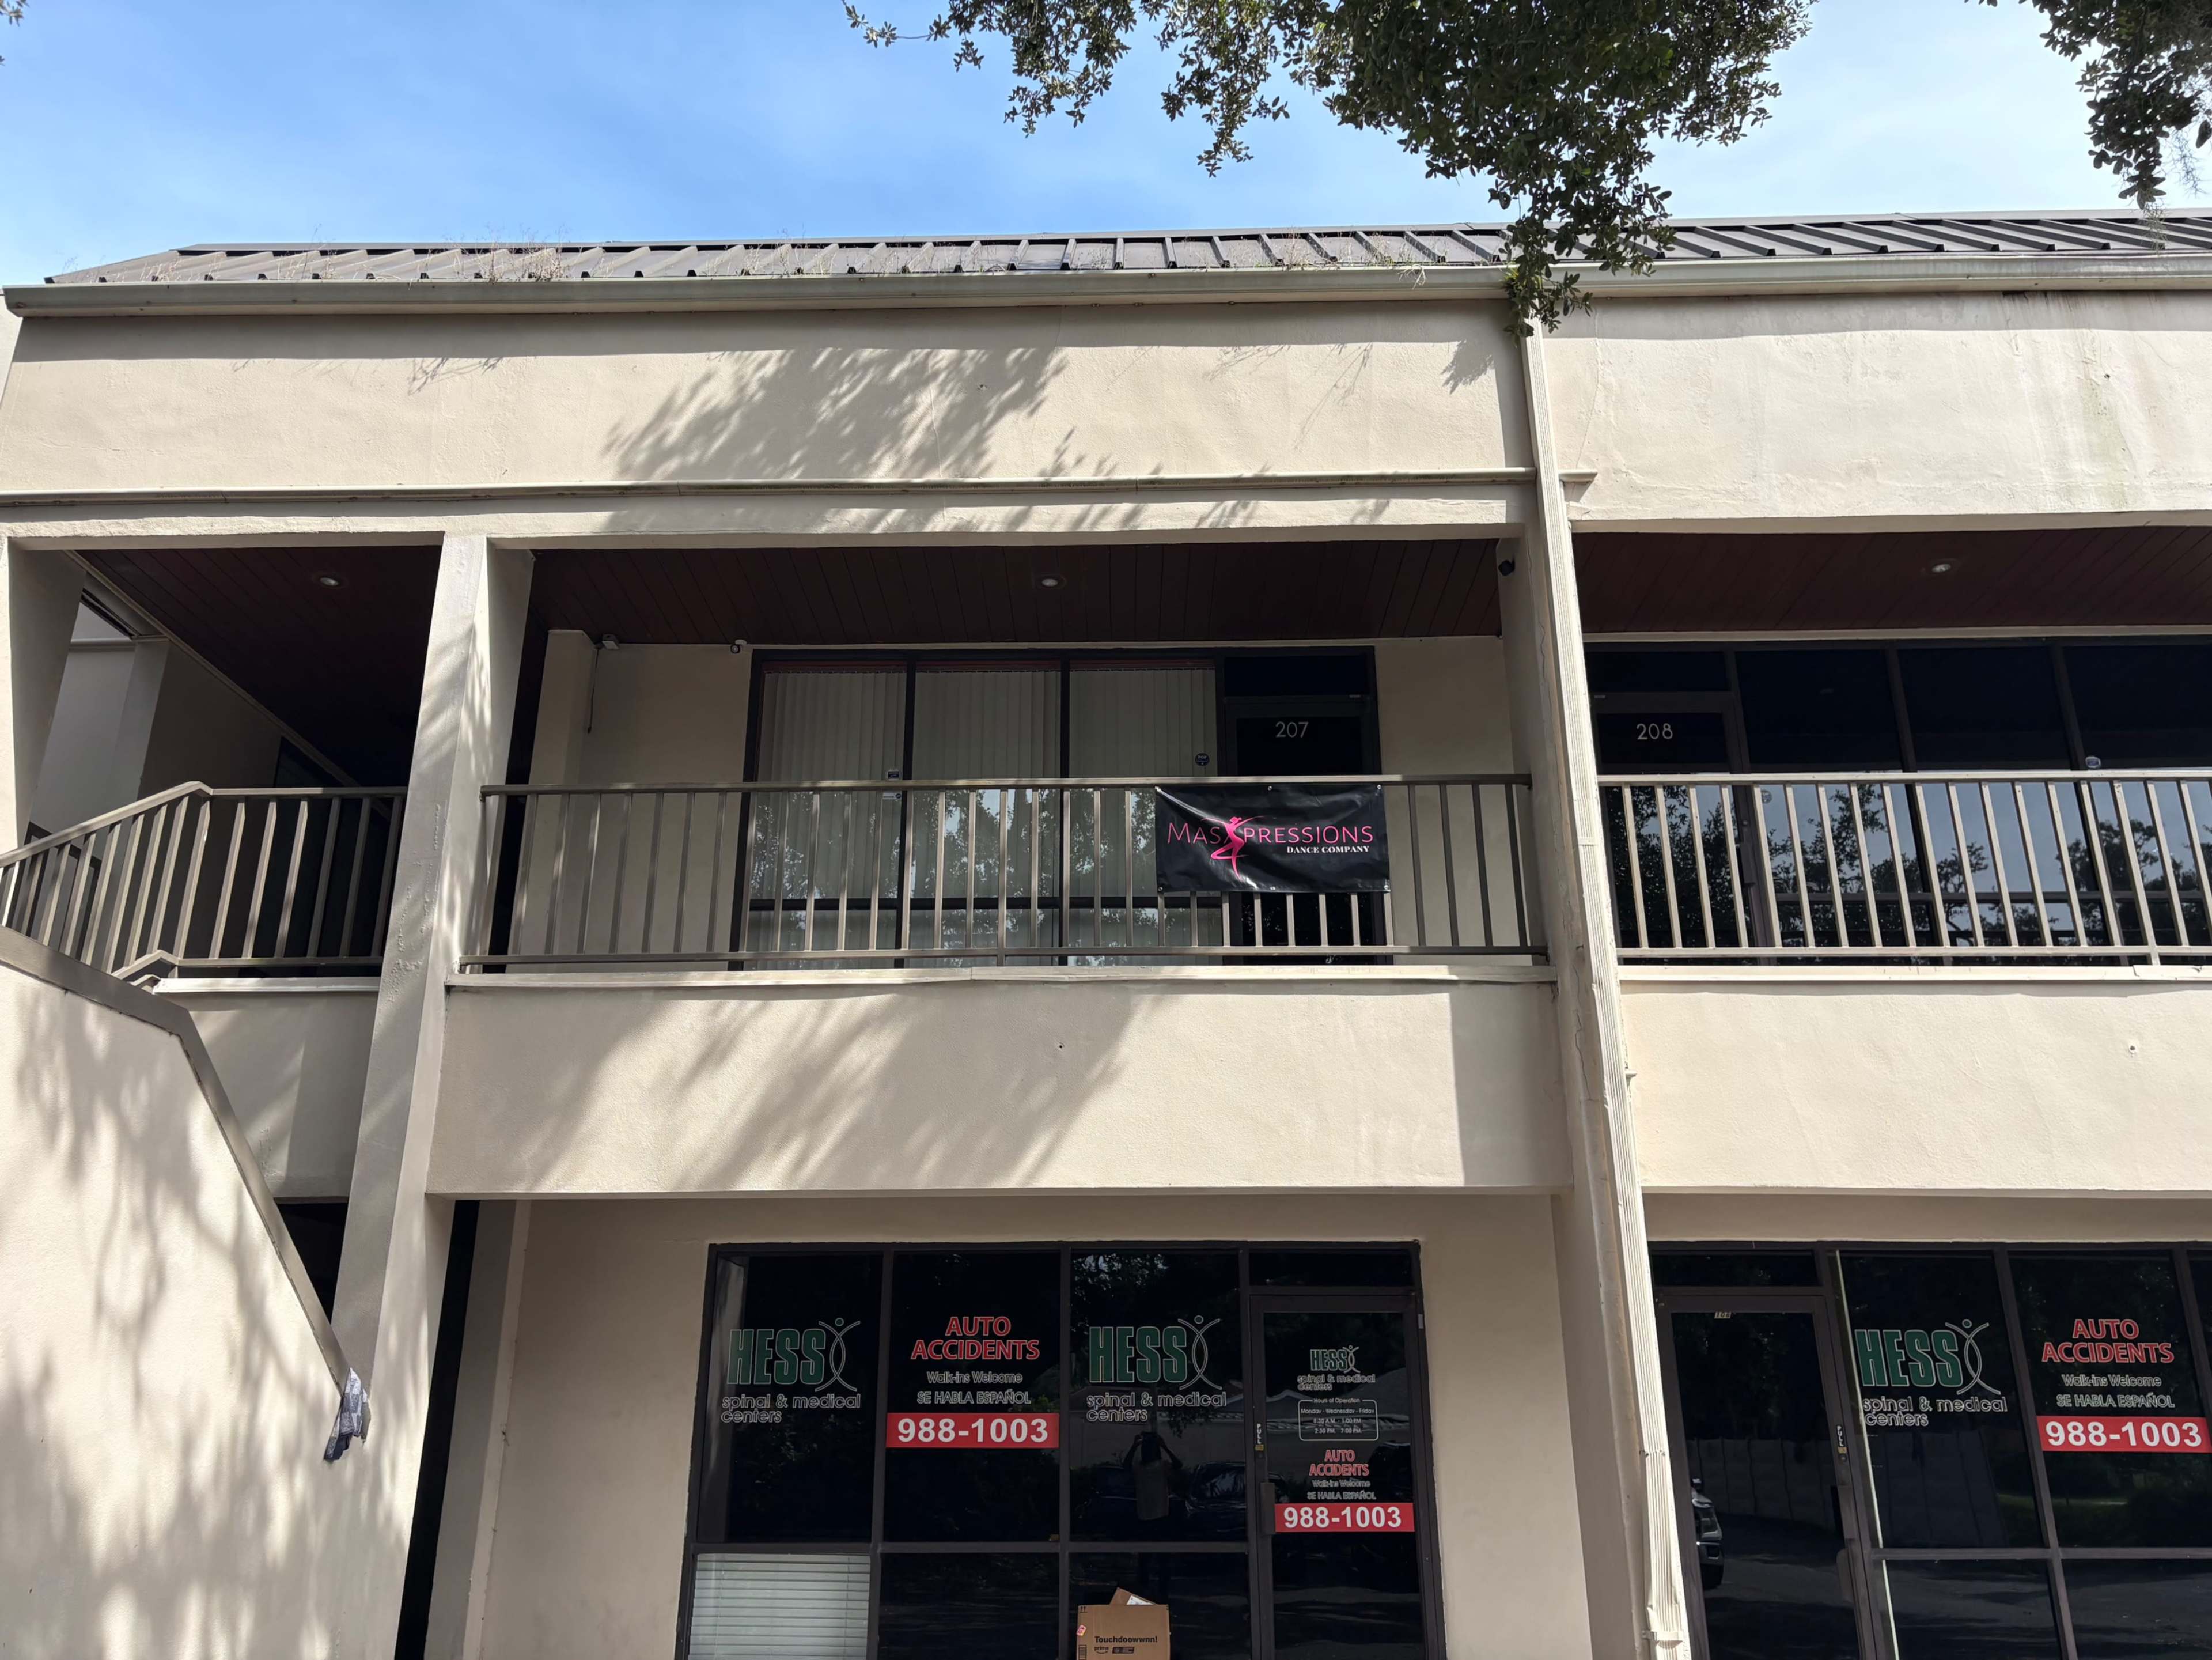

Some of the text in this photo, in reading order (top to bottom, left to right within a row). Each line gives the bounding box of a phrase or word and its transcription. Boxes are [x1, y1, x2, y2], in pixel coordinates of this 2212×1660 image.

[1275, 721, 1309, 738] 207
[1637, 723, 1673, 740] 208
[945, 1316, 1012, 1337] AUTO
[2072, 1318, 2139, 1340] AUTO
[726, 1329, 826, 1385] HESS
[910, 1339, 1040, 1360] ACCIDENTS
[1089, 1326, 1188, 1383] HESS
[1854, 1329, 1963, 1387] HESS
[2041, 1341, 2175, 1363] ACCIDENTS
[1310, 1349, 1347, 1371] HESS
[926, 1371, 1023, 1383] Walk-ins Welcome
[1297, 1374, 1325, 1384] spinal
[1336, 1374, 1376, 1383] medical
[2061, 1374, 2162, 1387] Walk-ins Welcome
[1297, 1382, 1332, 1391] centers
[722, 1393, 861, 1411] spinal & medical
[917, 1389, 1032, 1404] SE HABLA ESPAÑOL
[1086, 1391, 1226, 1410] spinal & medical
[1862, 1396, 2008, 1413] spinal & medical
[2056, 1392, 2176, 1408] SE HABLA ESPAÑOL
[721, 1409, 782, 1423] centers
[1086, 1407, 1148, 1422] centers
[1864, 1412, 1929, 1426] centers
[897, 1418, 1048, 1443] 988-1003
[2046, 1421, 2202, 1447] 988-1003
[1325, 1449, 1355, 1462] AUTO
[1309, 1464, 1369, 1477] ACCIDENTS
[1339, 1479, 1371, 1488] Welcome
[1307, 1489, 1377, 1500] SE HABLA ESPAÑOL
[1283, 1506, 1402, 1528] 988-1003
